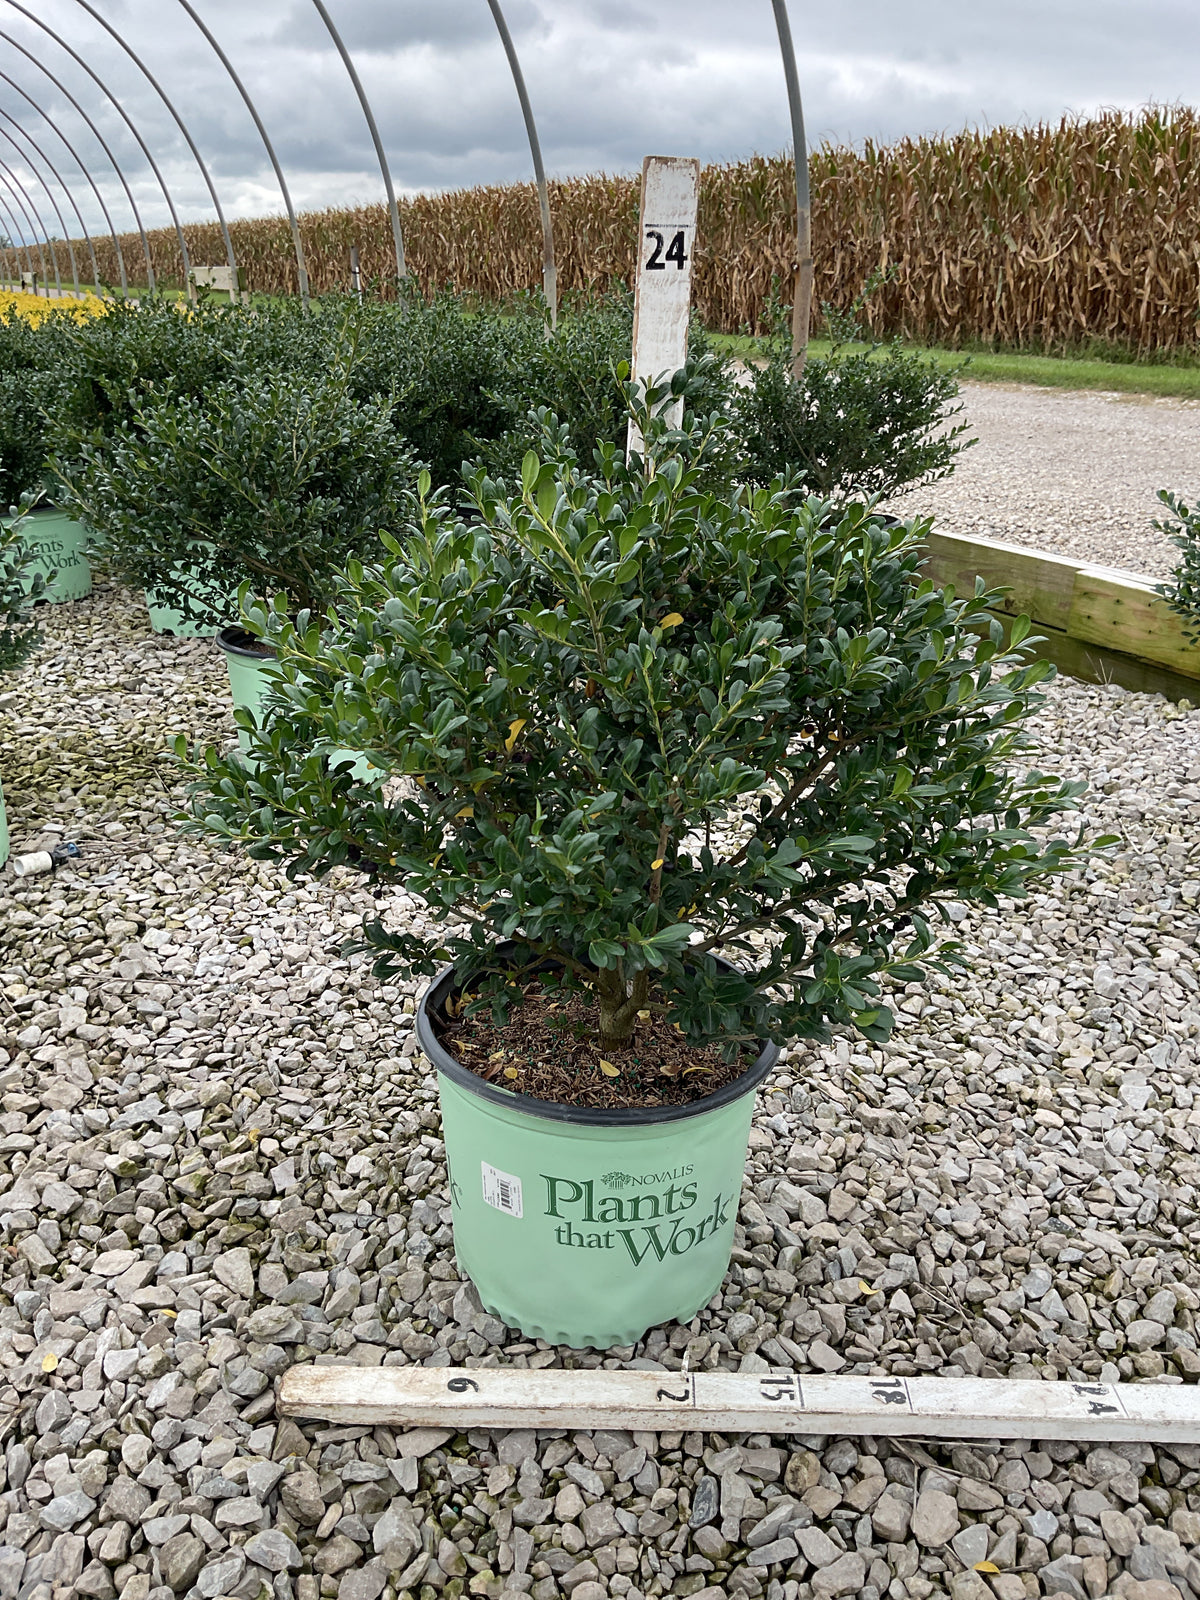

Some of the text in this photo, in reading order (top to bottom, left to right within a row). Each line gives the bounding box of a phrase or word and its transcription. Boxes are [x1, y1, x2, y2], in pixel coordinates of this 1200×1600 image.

[645, 230, 688, 271] 24
[40, 550, 81, 571] Work
[631, 1164, 694, 1188] NOVALIS
[539, 1173, 698, 1223] Plants
[554, 1193, 731, 1267] that Work
[760, 1375, 795, 1401] 15
[869, 1378, 907, 1405] 18
